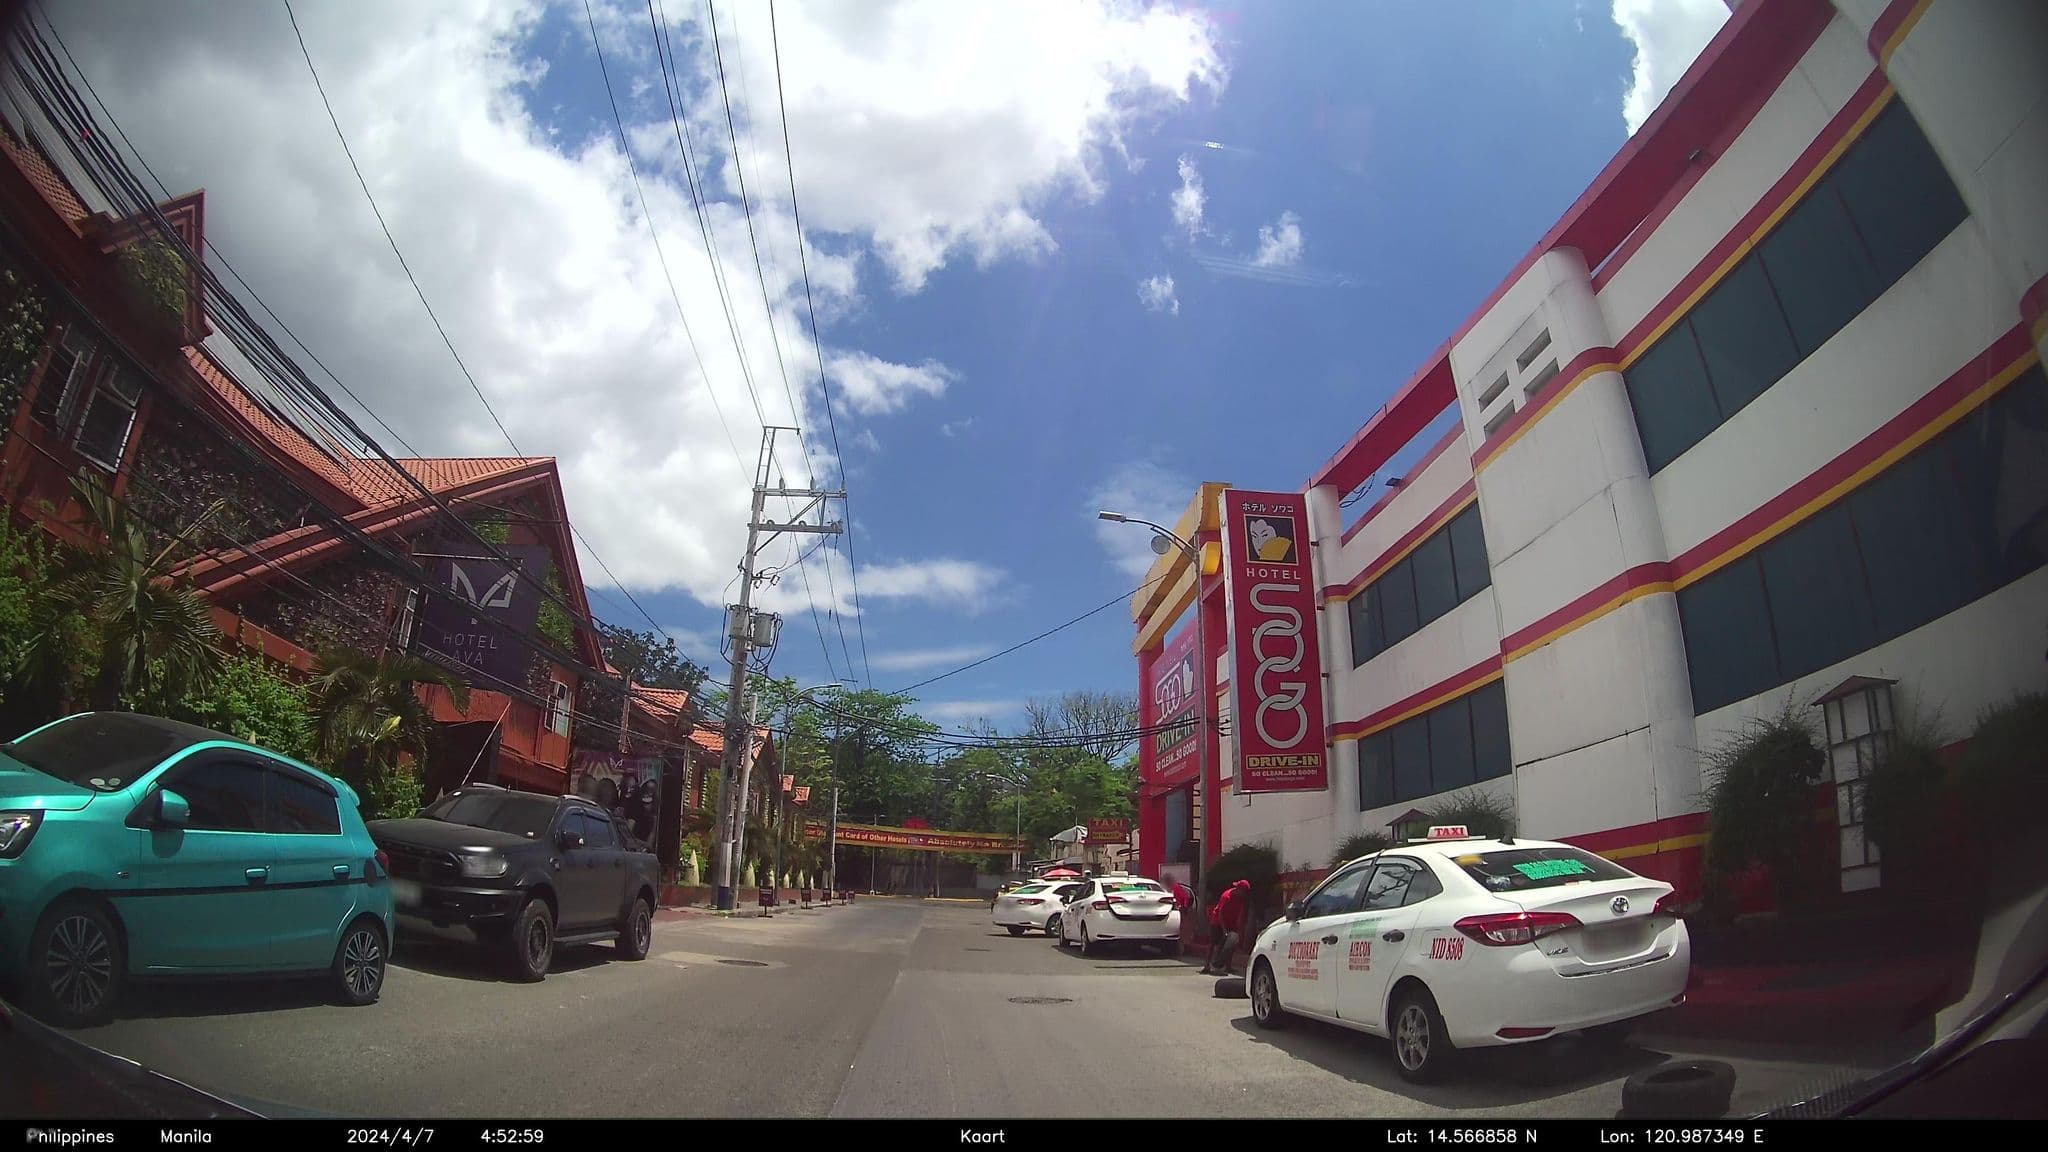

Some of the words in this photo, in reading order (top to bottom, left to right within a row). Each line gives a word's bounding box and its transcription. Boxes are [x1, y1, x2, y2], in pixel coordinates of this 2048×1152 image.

[1242, 503, 1267, 513] ホテル
[1246, 567, 1302, 580] HOTEL
[442, 632, 497, 649] HOTEL
[453, 650, 483, 665] AVA
[1250, 583, 1308, 749] SOGO
[1248, 756, 1319, 767] DRIVE-IN
[1434, 827, 1464, 836] TAXI
[845, 831, 860, 839] Card
[861, 832, 868, 840] of
[869, 833, 887, 842] Other
[928, 838, 974, 848] Absolutely
